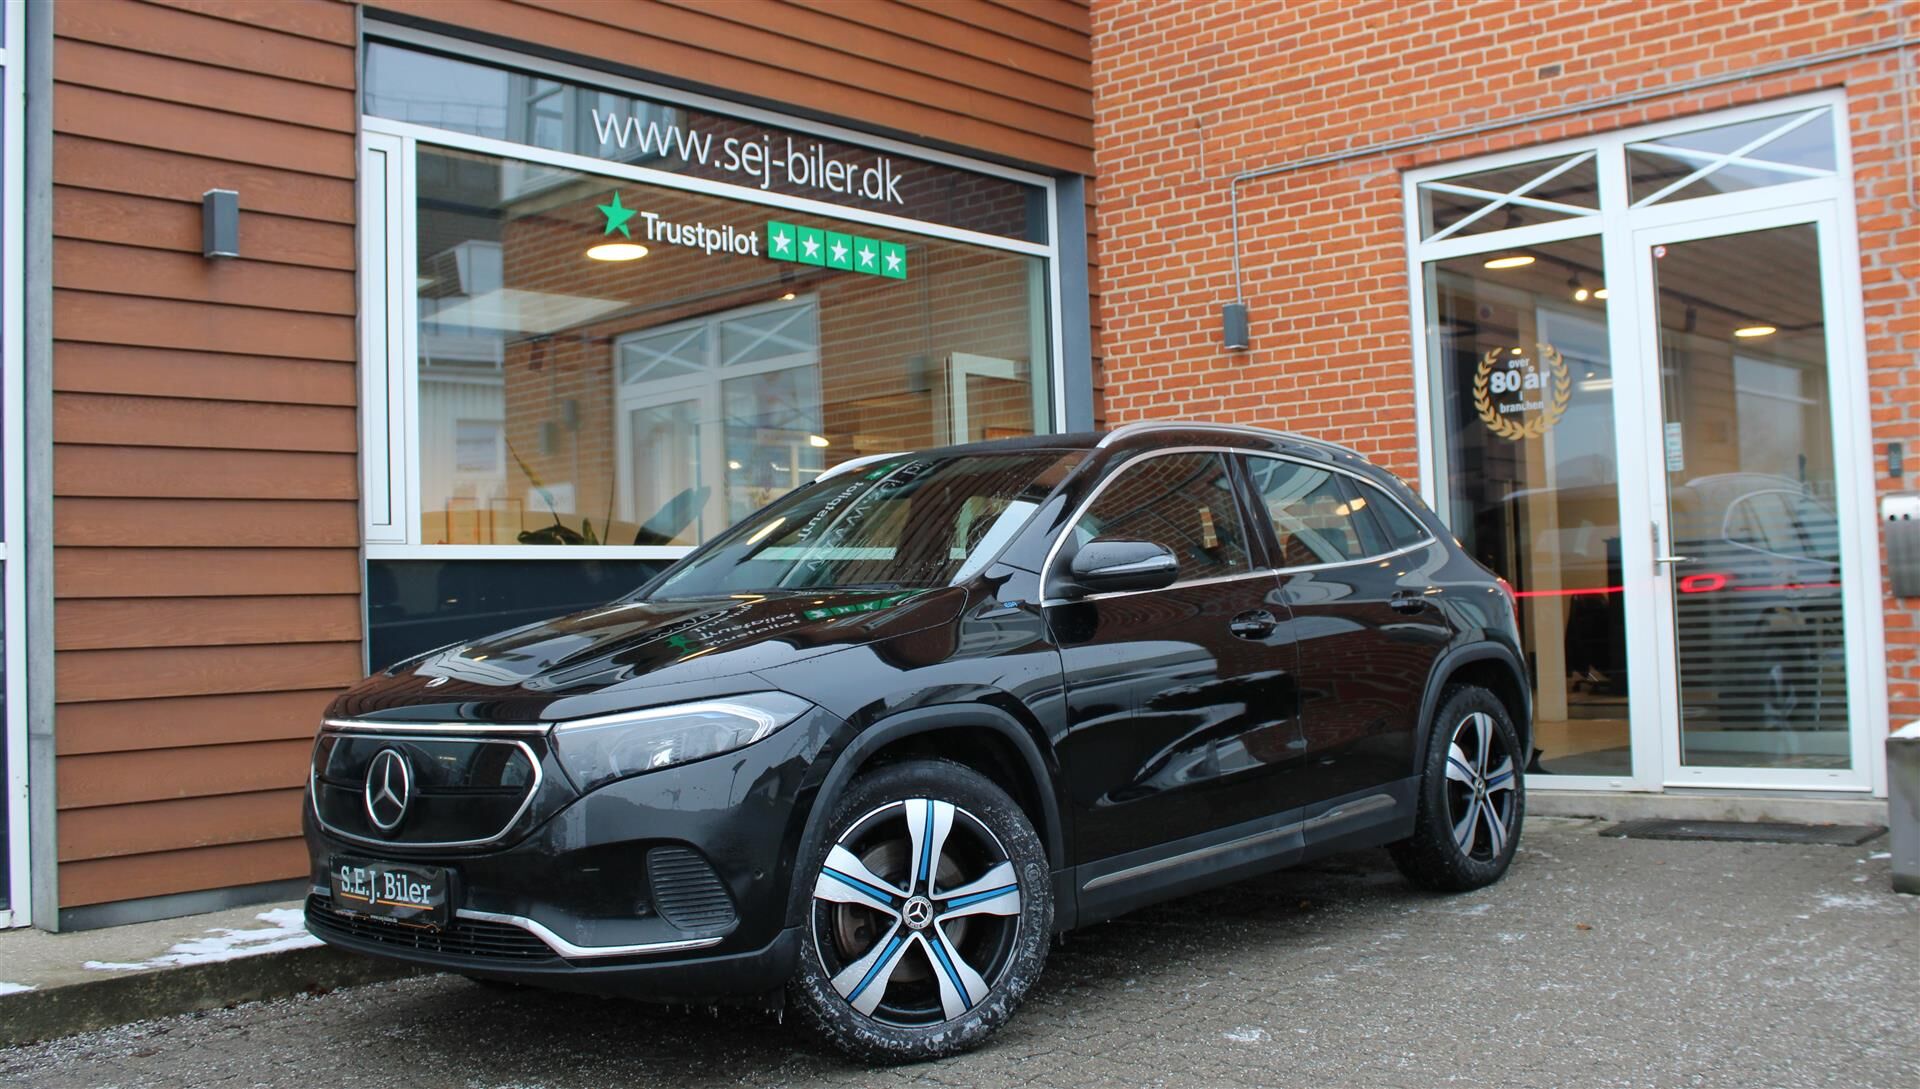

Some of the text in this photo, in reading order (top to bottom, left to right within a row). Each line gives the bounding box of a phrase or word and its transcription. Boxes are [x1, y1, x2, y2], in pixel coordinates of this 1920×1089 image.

[592, 108, 904, 204] www.sej-biler.dk
[641, 211, 759, 256] Trustpilot
[1490, 366, 1550, 393] 80 år
[1508, 358, 1530, 368] over
[1500, 401, 1544, 413] branchen
[341, 865, 431, 904] S.E.J. Biler
